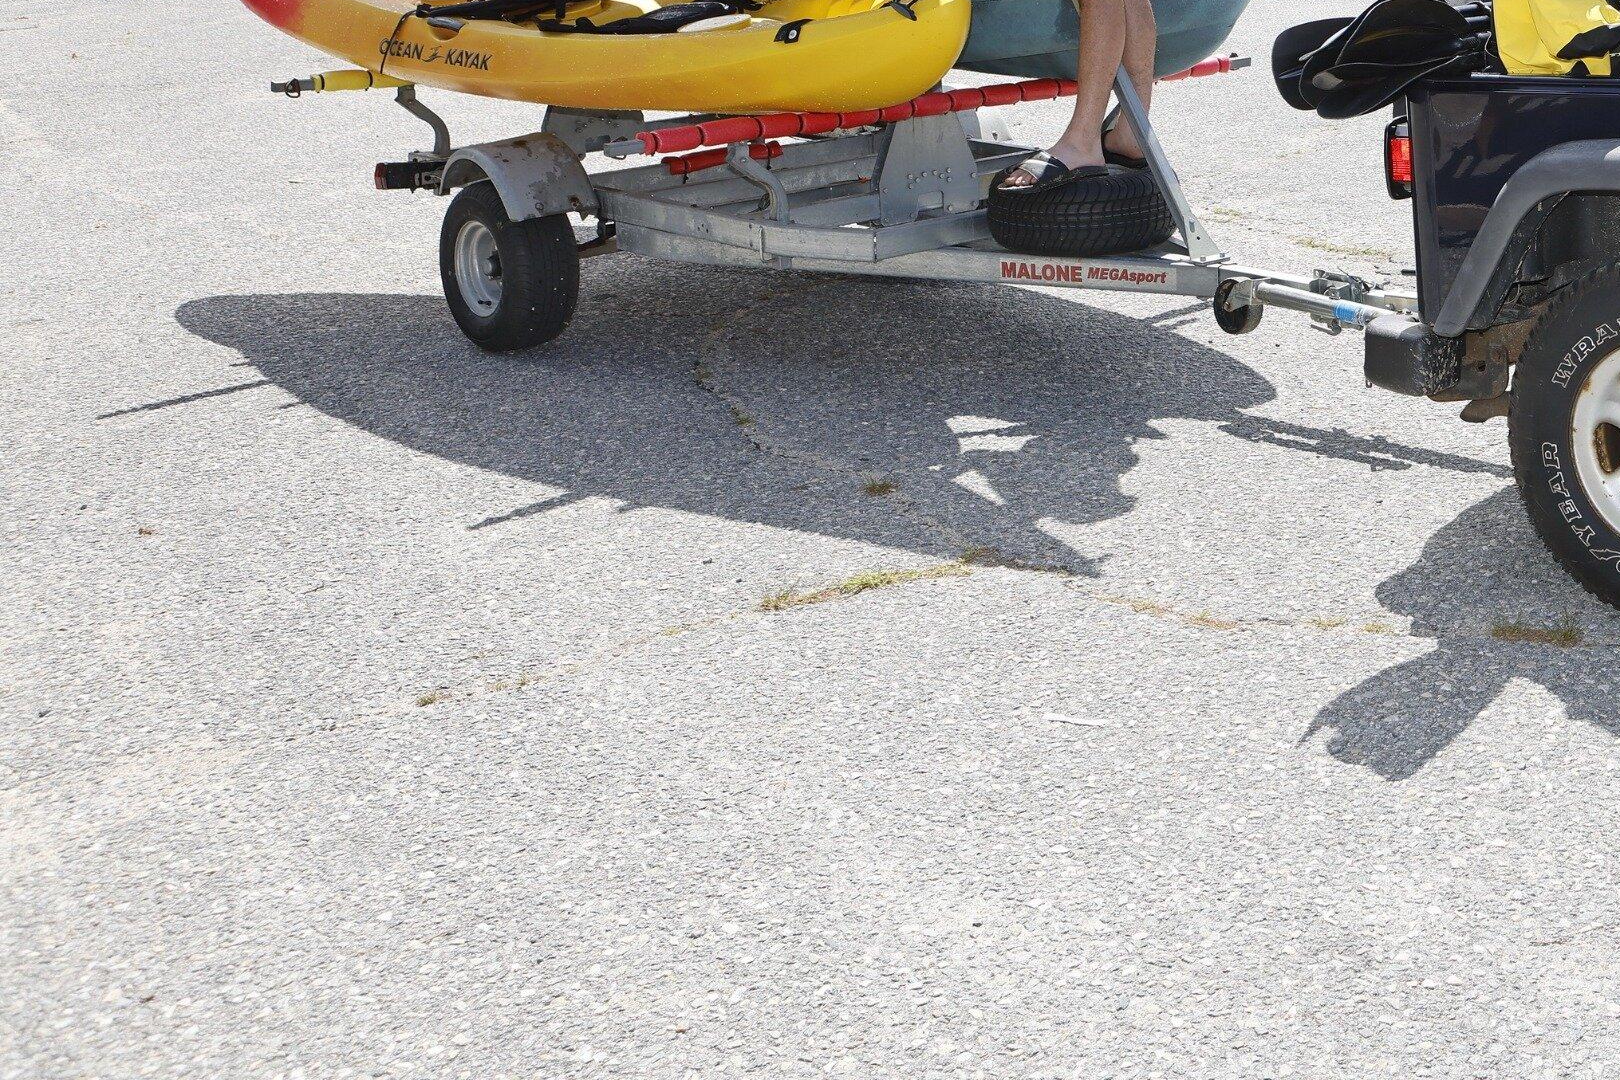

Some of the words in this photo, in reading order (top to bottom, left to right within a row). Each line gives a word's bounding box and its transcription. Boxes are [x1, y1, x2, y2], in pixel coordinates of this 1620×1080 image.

[379, 37, 424, 60] OCEAN
[444, 48, 493, 71] KAYAK
[1001, 261, 1083, 283] MALONE
[1087, 266, 1167, 285] MEGAsport
